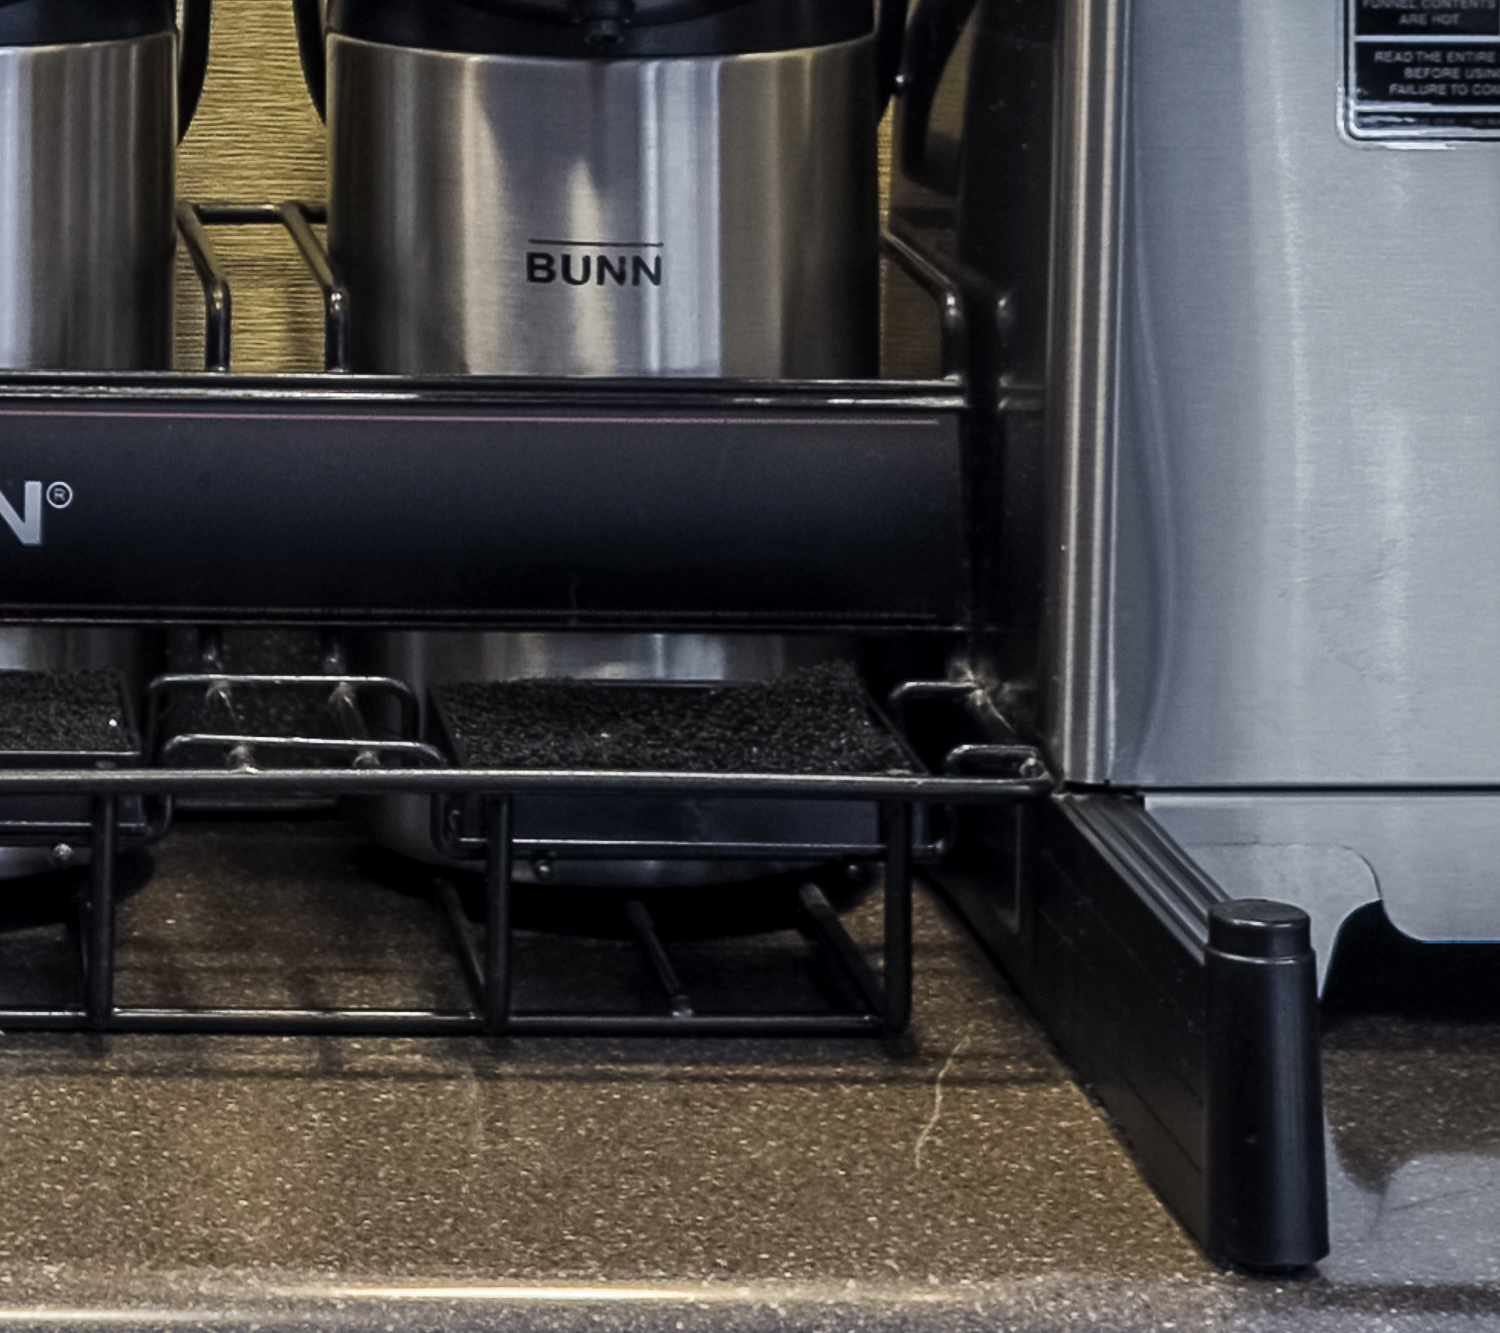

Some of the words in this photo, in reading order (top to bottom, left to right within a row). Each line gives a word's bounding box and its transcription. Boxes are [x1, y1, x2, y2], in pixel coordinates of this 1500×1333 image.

[1398, 13, 1427, 25] ARE
[1431, 13, 1461, 25] HOT
[1374, 51, 1413, 63] READ
[1416, 51, 1443, 63] THE
[1446, 51, 1496, 63] ENTIRE
[1404, 67, 1461, 80] BEFORE
[1389, 84, 1447, 96] FAILURE
[1450, 84, 1468, 96] TO
[526, 251, 662, 286] BUNN
